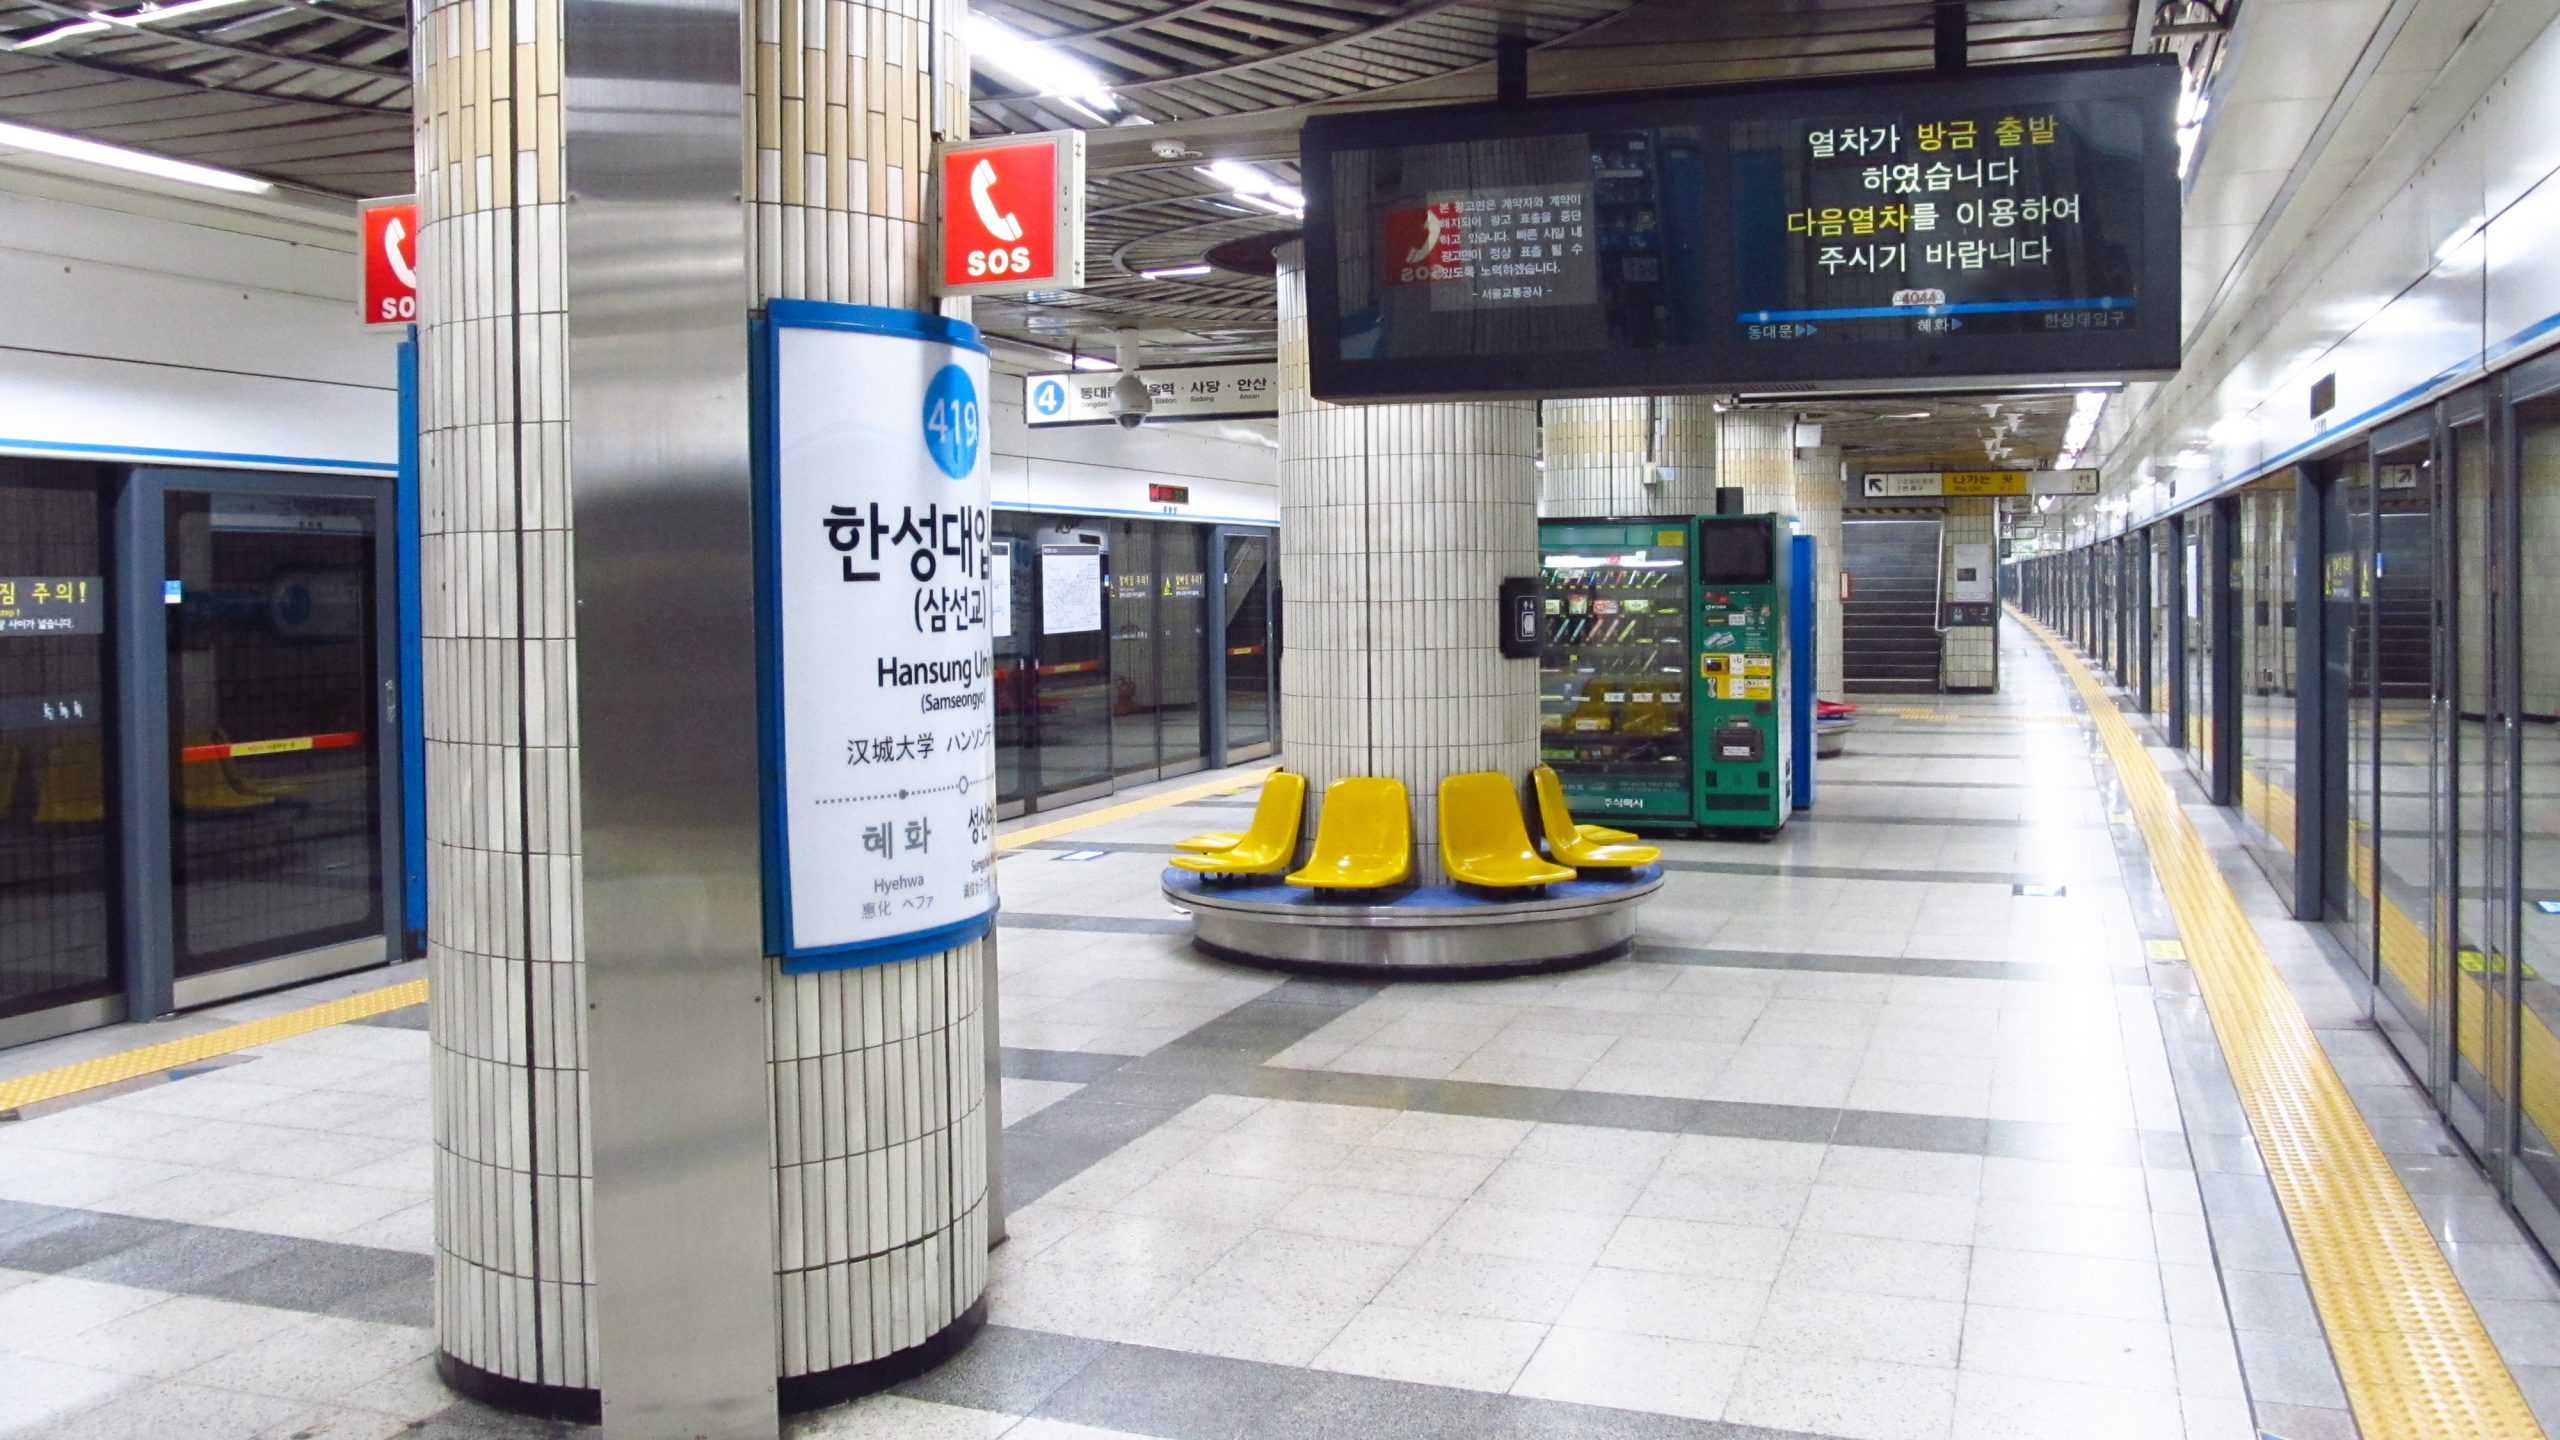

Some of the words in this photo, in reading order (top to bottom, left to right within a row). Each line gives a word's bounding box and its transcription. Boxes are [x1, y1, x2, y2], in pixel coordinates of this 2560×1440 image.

[1808, 124, 1901, 158] 열차가
[1917, 120, 1977, 152] 방금
[1994, 114, 2059, 145] 출발
[1862, 157, 2019, 194] 하였습니다
[1502, 196, 1544, 209] 계약자와
[1549, 194, 1581, 207] 계약이
[1490, 214, 1511, 227] 광고
[1787, 201, 1940, 237] 다음열차를
[1956, 193, 2081, 228] 이용하여
[1439, 234, 1461, 246] 하고
[1468, 231, 1510, 243] 있습니다.
[1571, 243, 1583, 256] 수
[967, 246, 1030, 277] SOS
[1818, 243, 1907, 275] 주시기
[1926, 236, 2051, 269] 바랍니다
[1482, 286, 1542, 300] 서울교통공사
[381, 296, 416, 319] SO
[1747, 324, 1793, 340] 동대문
[1917, 317, 1950, 333] 혜화
[1038, 384, 1057, 411] 4
[1143, 383, 1175, 397] 울역
[1191, 380, 1221, 393] 사당
[1237, 377, 1267, 391] 안산
[928, 397, 978, 447] 419
[1953, 475, 1991, 484] 나가는
[31, 581, 87, 604] 주의!
[915, 587, 986, 632] (삼선교)
[8, 619, 35, 630] 사이가
[877, 657, 972, 689] Hansung
[847, 732, 935, 766] 汉城大学
[873, 873, 925, 895] Hyehwa
[861, 899, 892, 920] 惠化
[902, 894, 935, 913] ヘファ
